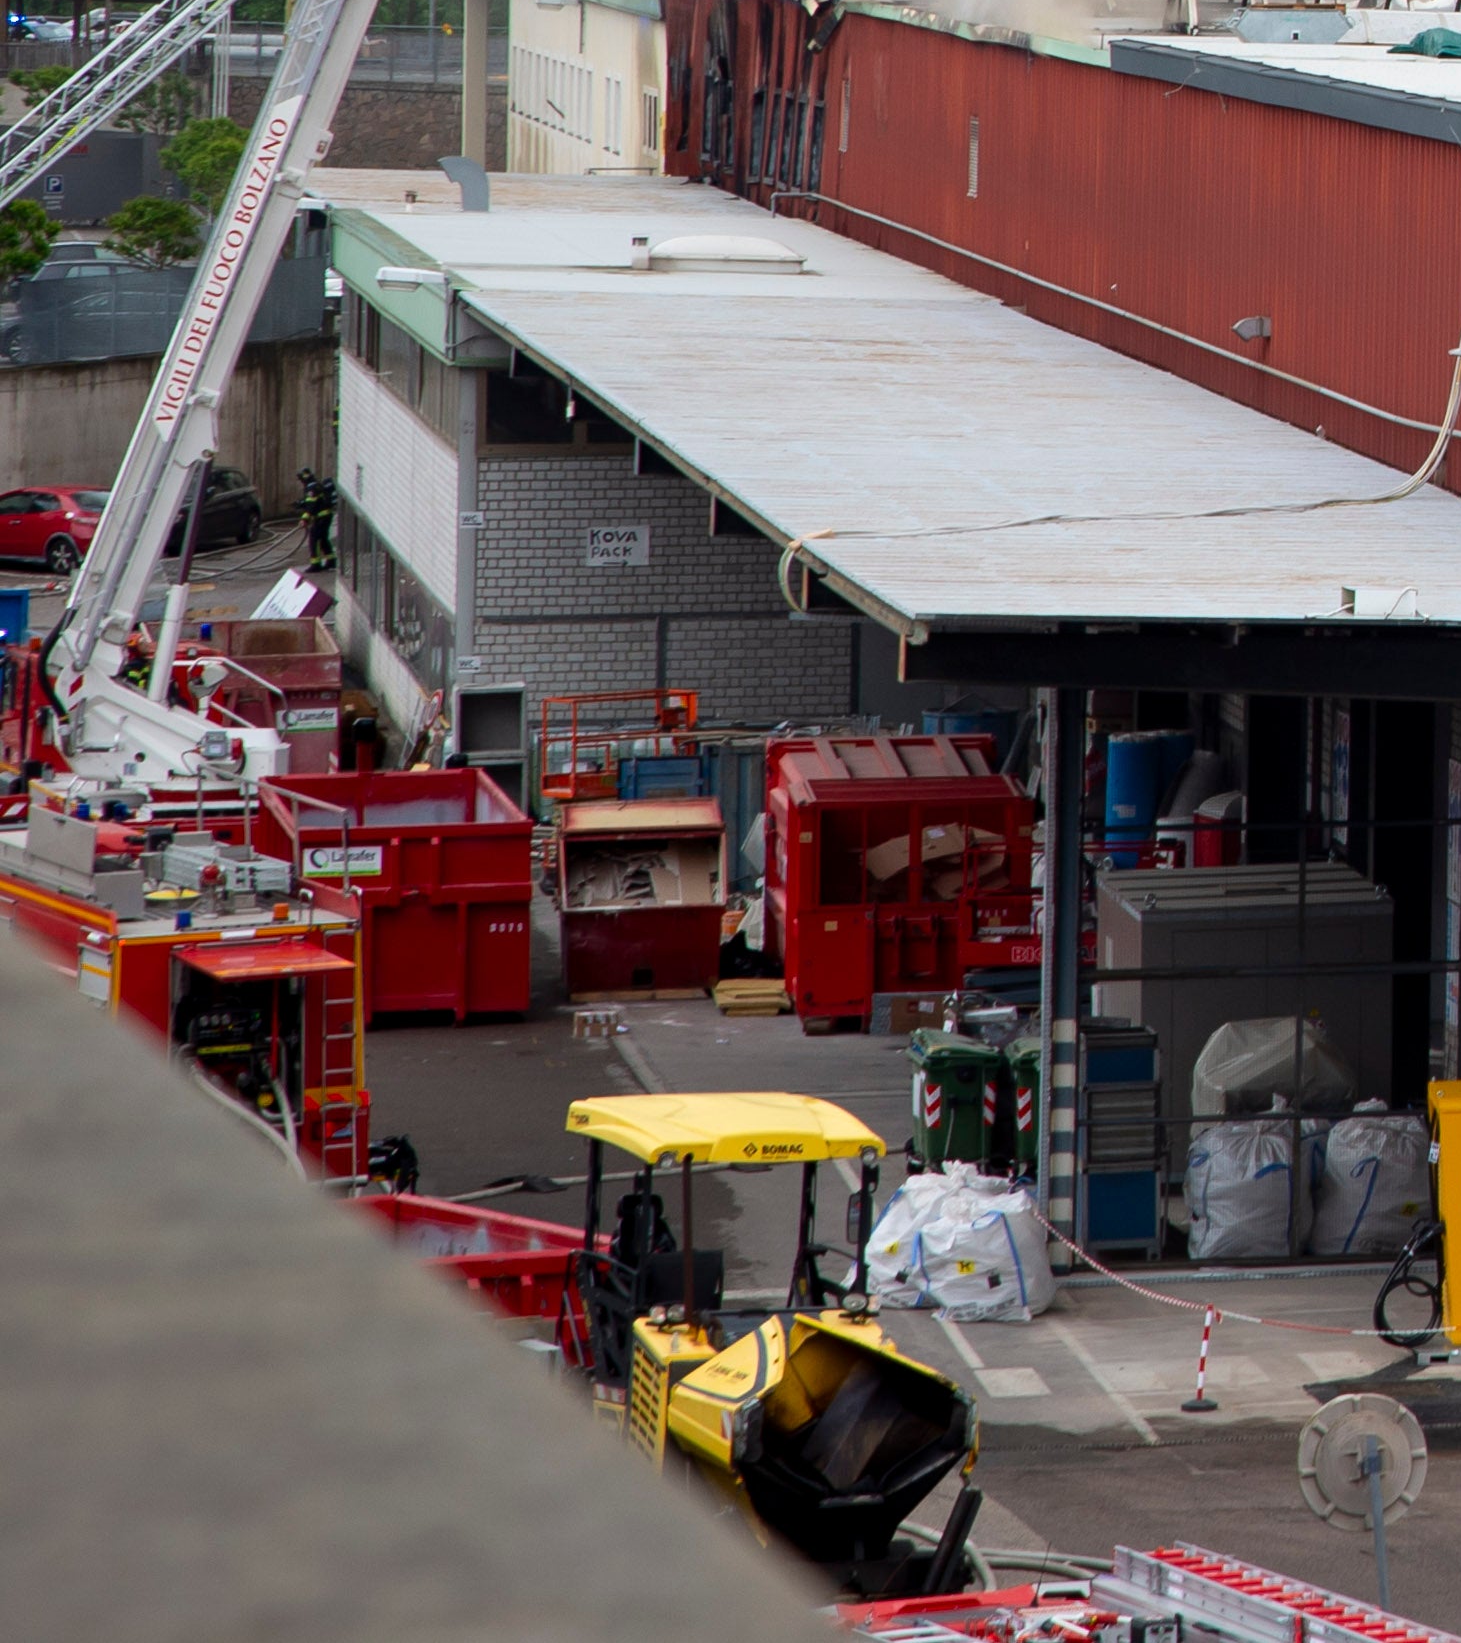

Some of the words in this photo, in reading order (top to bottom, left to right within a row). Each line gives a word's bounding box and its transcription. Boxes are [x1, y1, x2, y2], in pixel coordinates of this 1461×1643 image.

[156, 358, 195, 423] VIGILI
[183, 316, 213, 354] DEL
[200, 230, 244, 310] FUOCO
[234, 118, 289, 225] BOLZANO
[590, 529, 639, 546] KOVA
[590, 546, 633, 558] PACK
